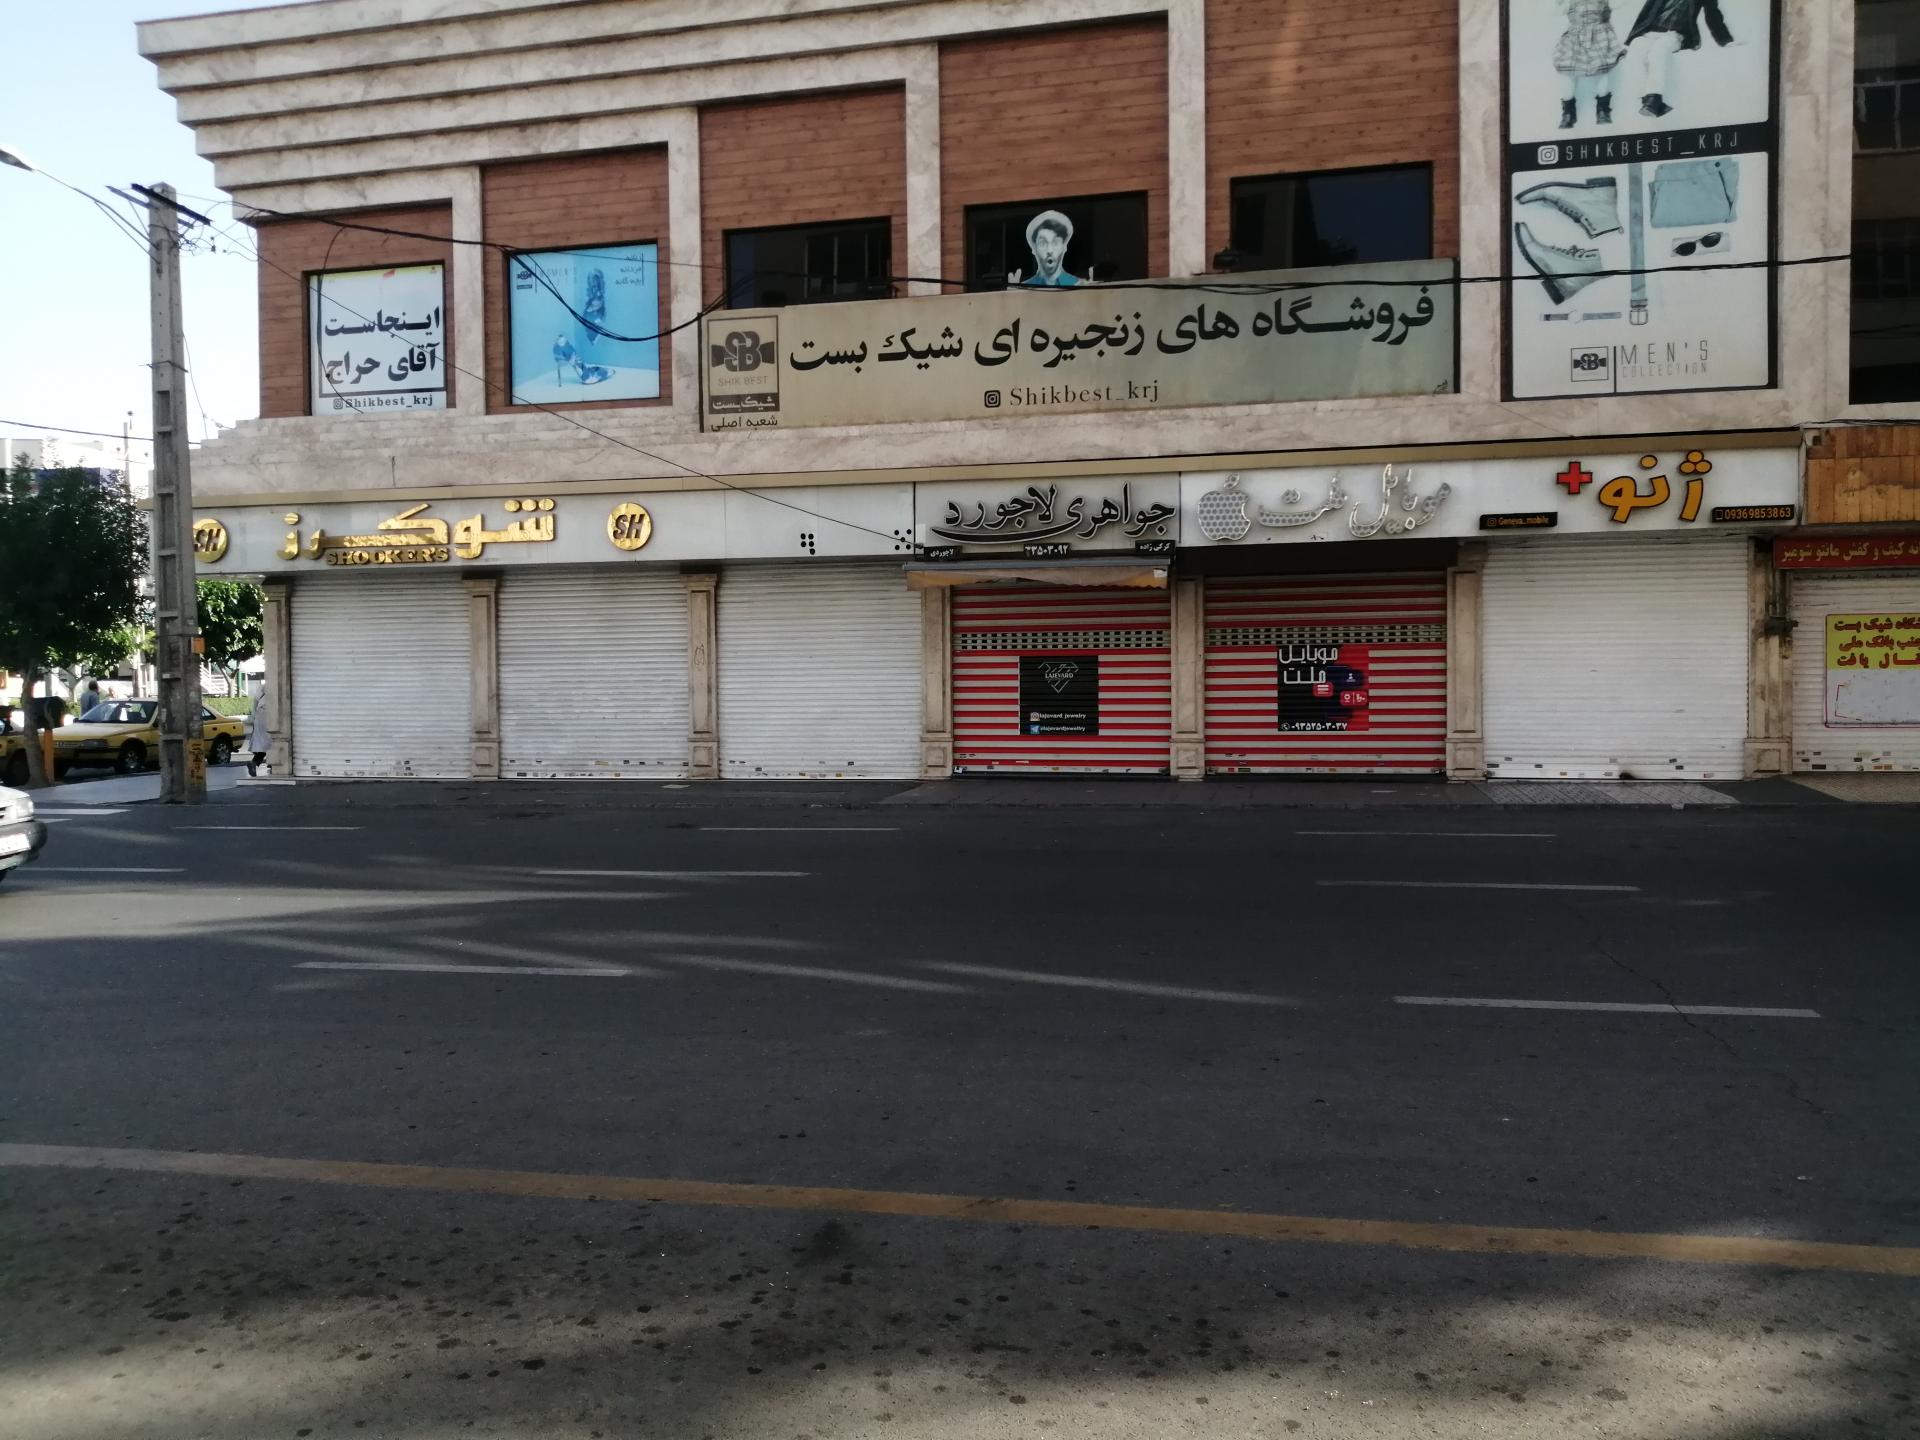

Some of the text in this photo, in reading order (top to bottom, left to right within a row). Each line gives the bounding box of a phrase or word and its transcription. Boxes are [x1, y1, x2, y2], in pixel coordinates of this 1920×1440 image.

[1566, 134, 1738, 161] SHIKBEST_KRJ
[325, 306, 440, 339] اینجاست
[1157, 303, 1240, 355] های
[1252, 285, 1434, 345] فروشگاه
[974, 317, 1021, 367] ای
[1031, 311, 1145, 369] زنجیره
[1620, 340, 1709, 365] MEN'S
[324, 342, 441, 385] آقای حراج
[789, 340, 868, 374] بست
[718, 375, 769, 387] SHIK BEST
[1009, 380, 1158, 408] Shikbest_krj
[345, 394, 434, 409] Shikbest_krj
[711, 416, 779, 432] شعبه اصلی
[1598, 450, 1713, 524] ژنو
[945, 483, 1058, 530] لاجورد
[1725, 507, 1792, 520] 09369853863
[276, 498, 555, 560] شوکرز
[612, 513, 645, 539] SH
[1278, 644, 1339, 665] موبایل
[1283, 666, 1327, 685] ملت
